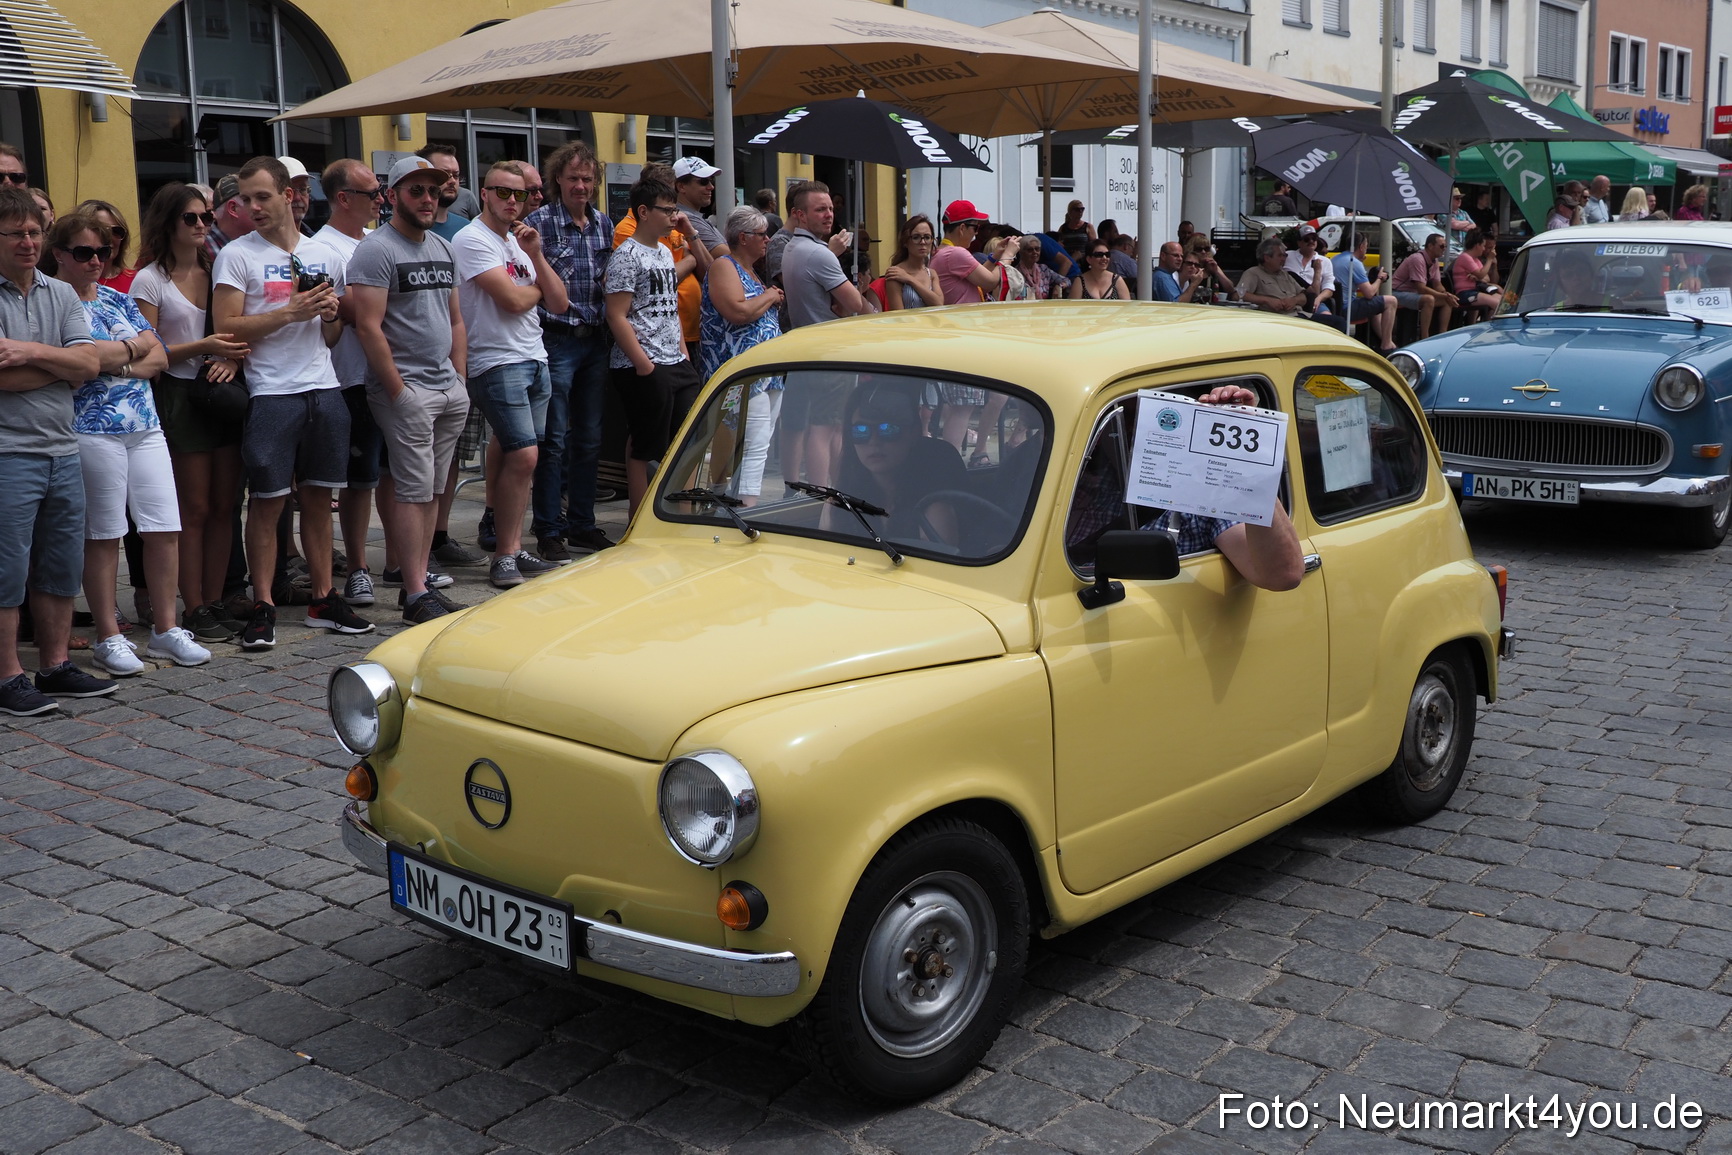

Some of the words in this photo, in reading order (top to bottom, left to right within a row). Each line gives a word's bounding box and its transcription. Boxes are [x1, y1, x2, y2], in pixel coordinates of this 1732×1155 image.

[748, 109, 810, 144] now
[901, 118, 952, 163] now
[1120, 157, 1132, 174] 30
[1283, 148, 1329, 182] now
[1109, 178, 1129, 195] Bang
[1391, 166, 1423, 211] now
[1604, 245, 1665, 255] BLUEBOY
[407, 266, 453, 286] adidas
[1697, 296, 1720, 307] 628
[1208, 421, 1260, 453] 533
[1474, 477, 1498, 496] AN
[1511, 479, 1536, 498] PK
[1540, 481, 1565, 500] 5H
[471, 785, 506, 802] ZASTAVA
[397, 884, 403, 897] D
[405, 862, 440, 916] NM
[458, 884, 497, 938] OH
[503, 900, 543, 952] 23
[548, 913, 563, 928] 03
[550, 945, 563, 960] 11
